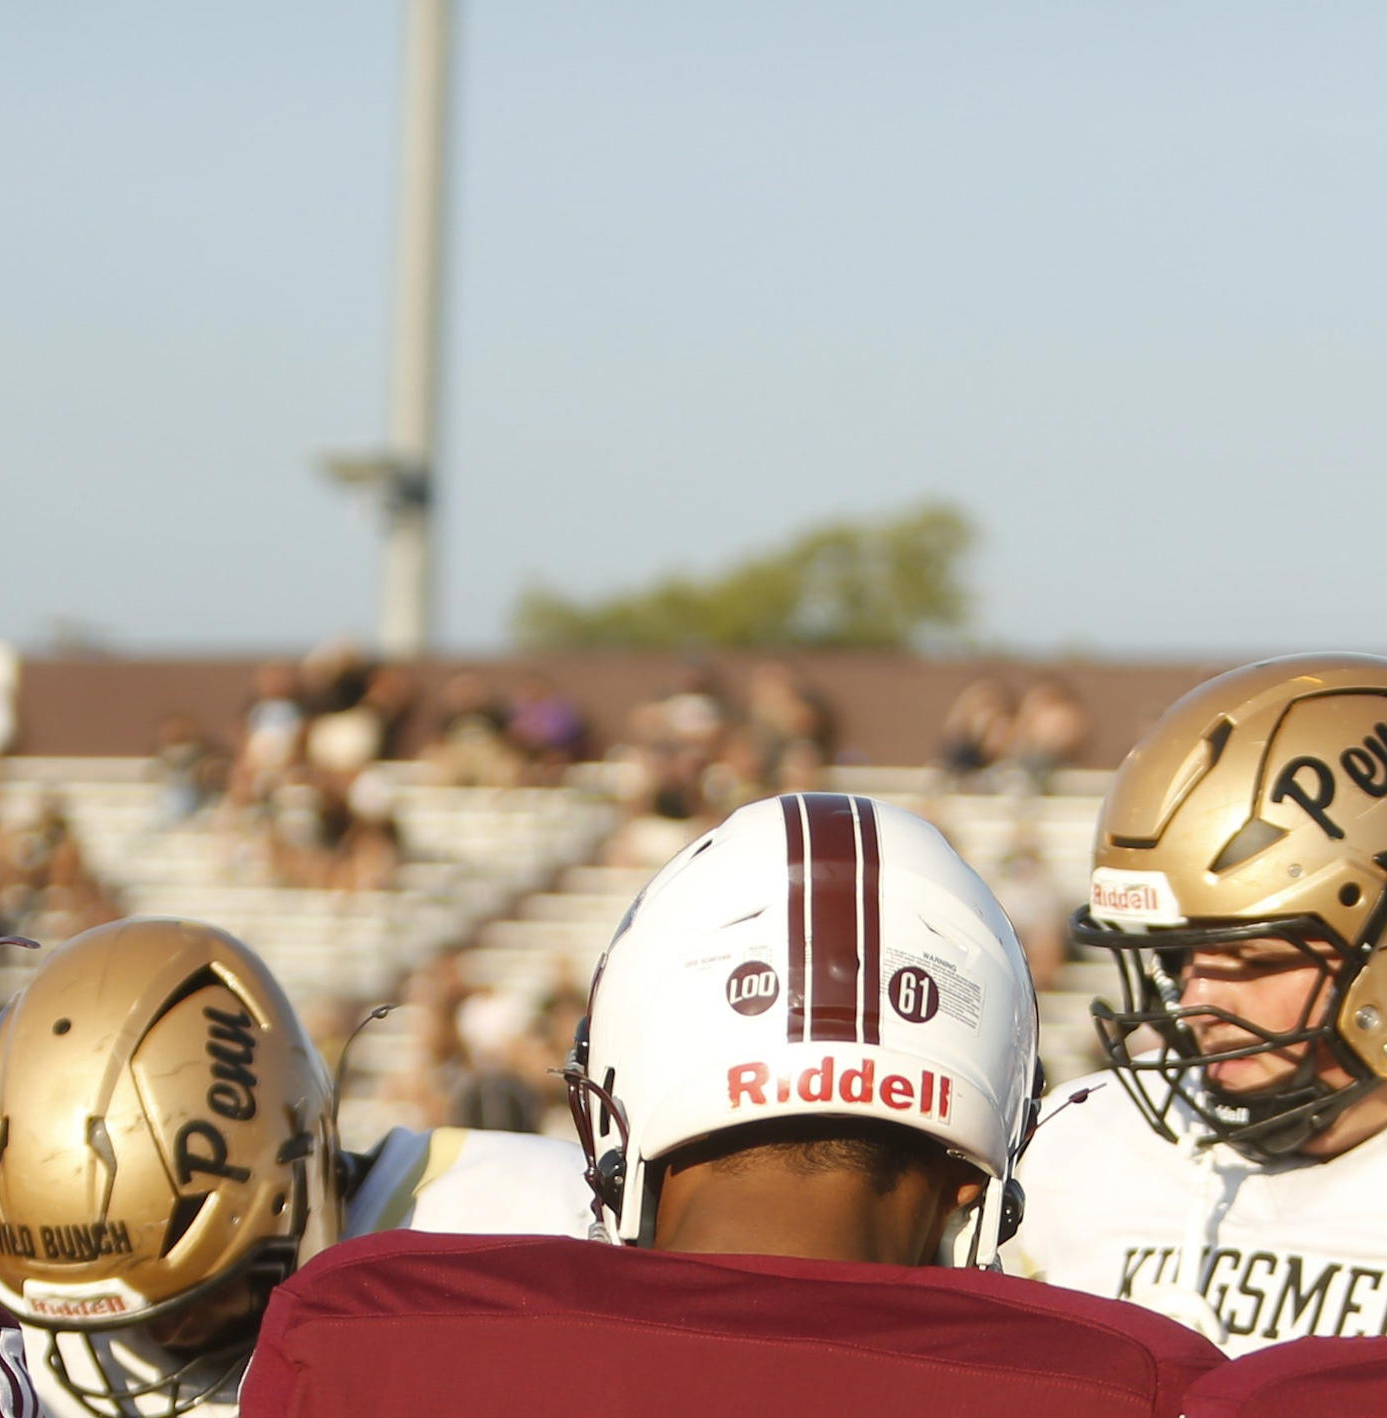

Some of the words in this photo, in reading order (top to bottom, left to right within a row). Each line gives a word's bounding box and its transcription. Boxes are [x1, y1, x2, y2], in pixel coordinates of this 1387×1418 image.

[729, 971, 776, 1004] LOD
[898, 971, 930, 1018] 61
[174, 1006, 258, 1186] Penn
[726, 1056, 952, 1121] Riddell
[40, 1220, 133, 1261] BUNCH
